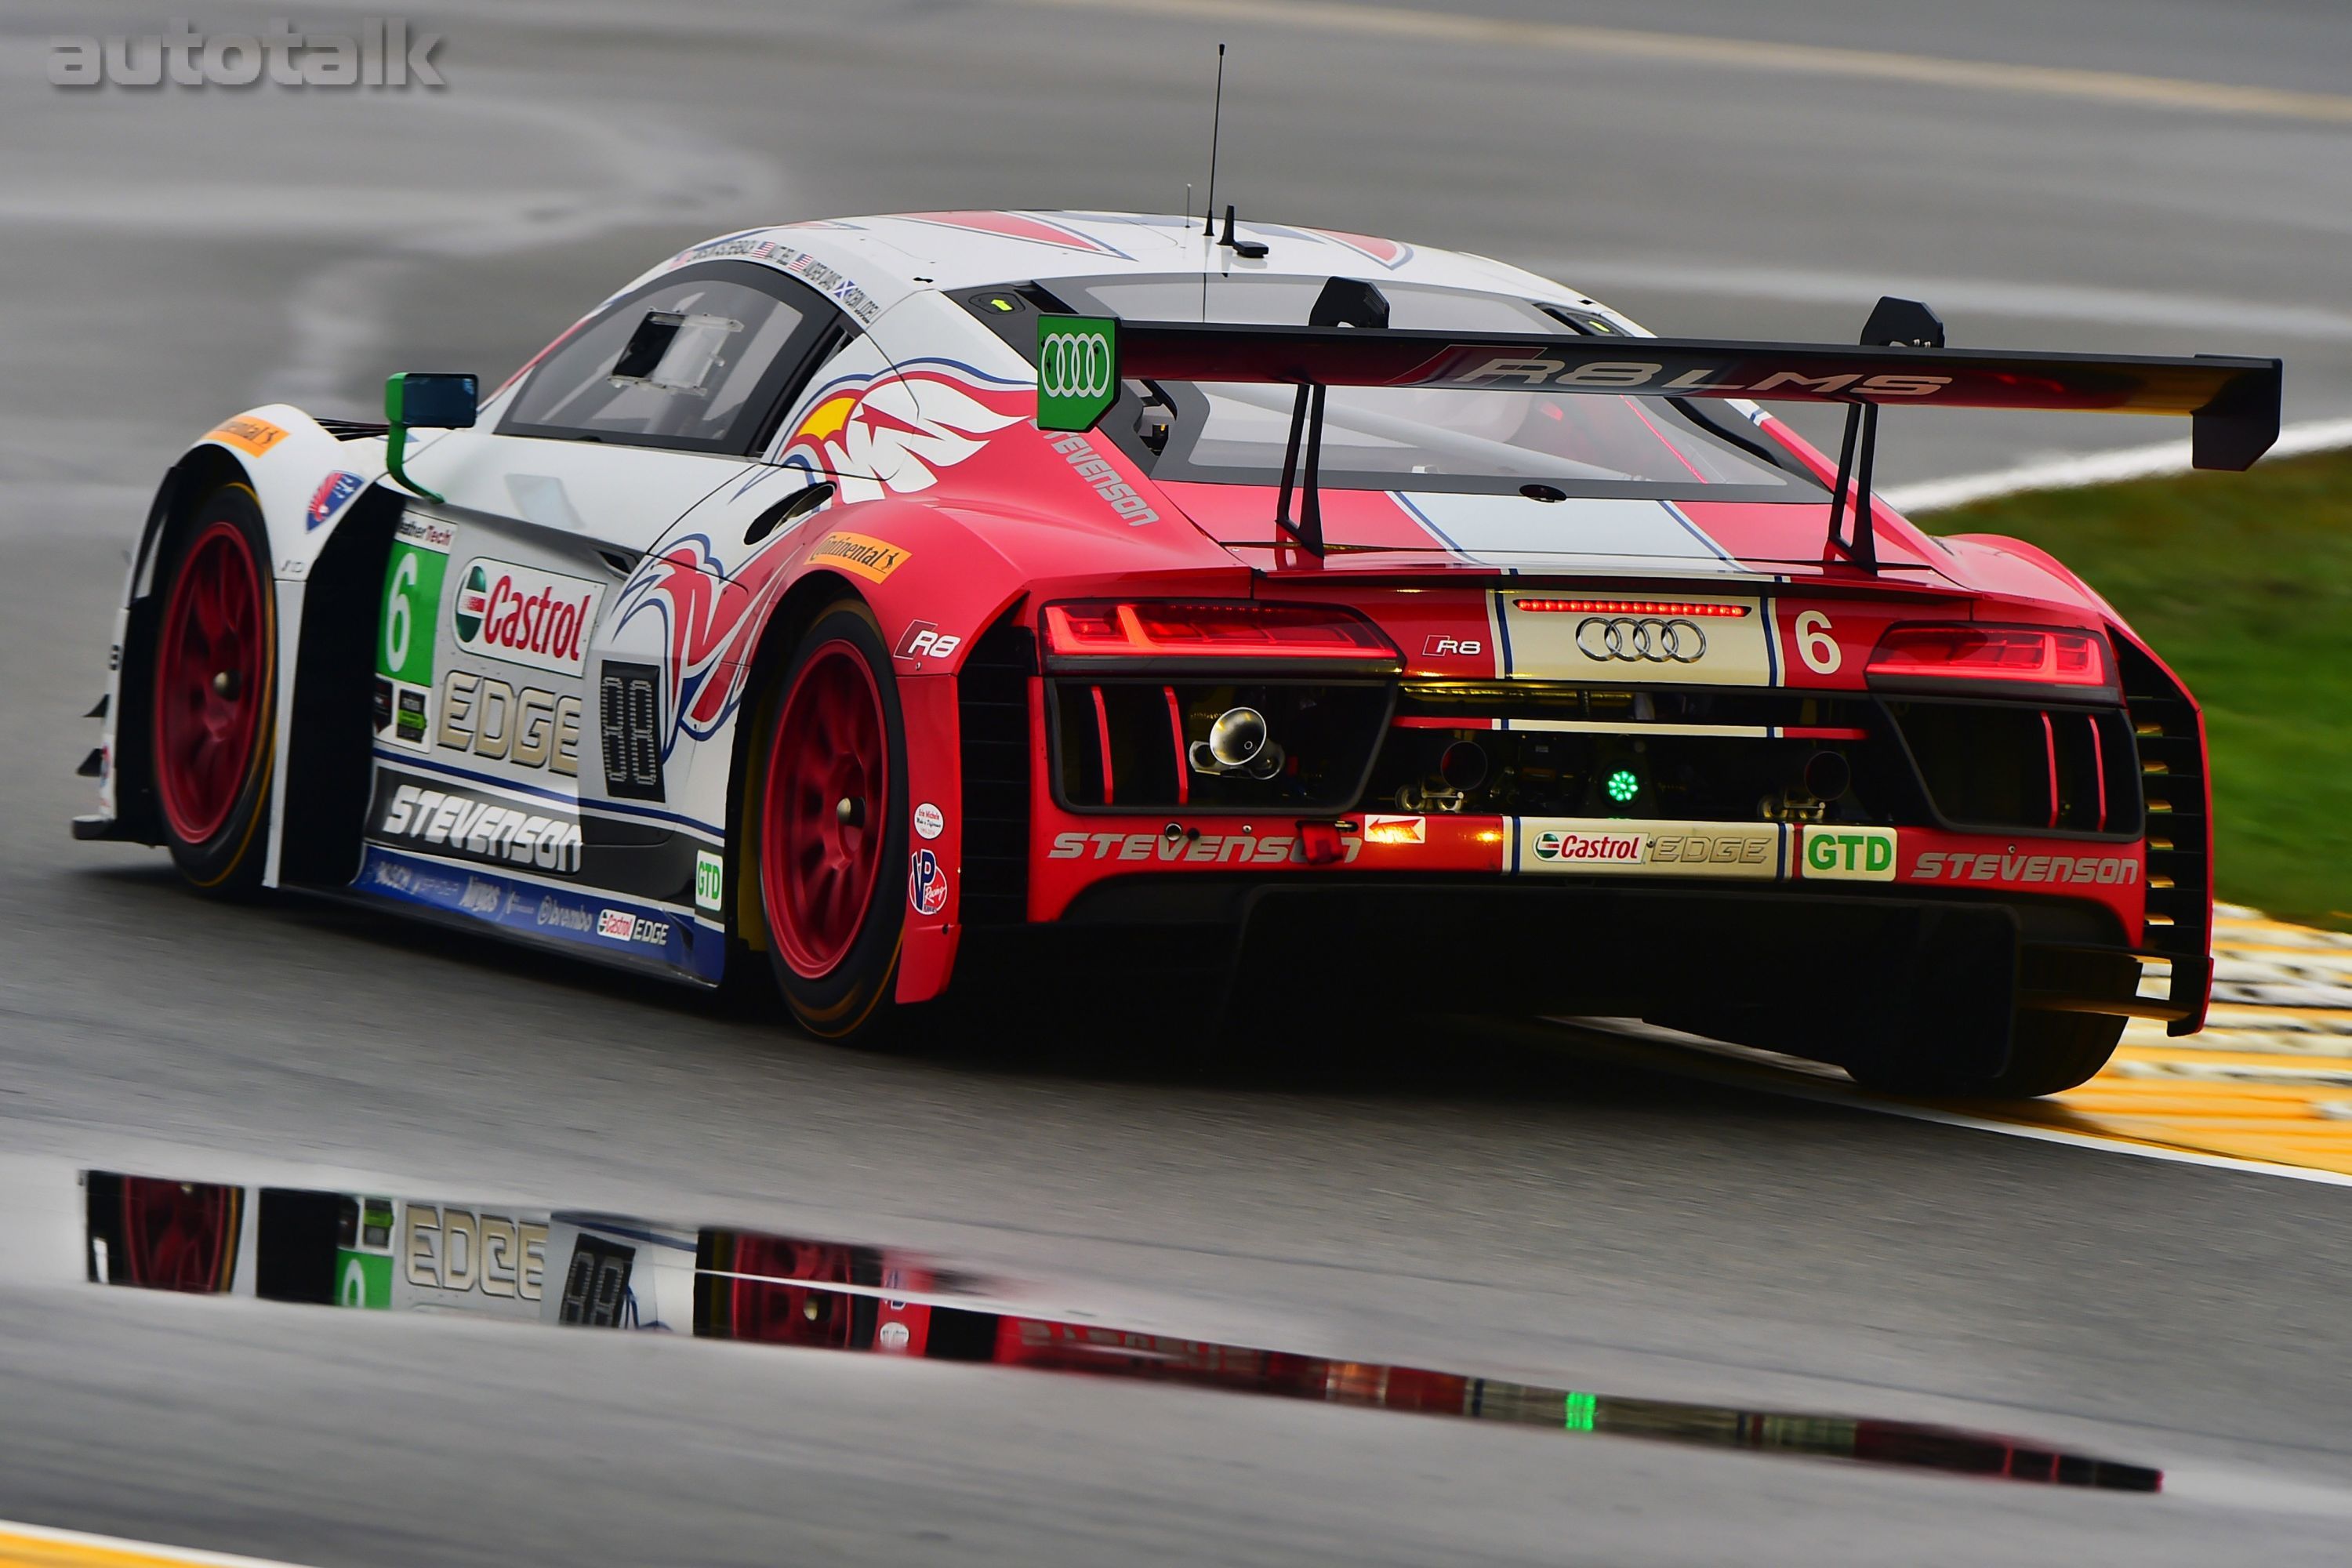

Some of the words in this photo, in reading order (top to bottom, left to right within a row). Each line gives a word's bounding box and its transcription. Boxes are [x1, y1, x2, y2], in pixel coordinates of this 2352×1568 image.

[1454, 358, 1663, 387] R8
[1661, 369, 1953, 396] LMS
[400, 518, 452, 546] eatherTech
[810, 535, 889, 569] Continental
[385, 552, 418, 673] 6
[484, 575, 591, 662] Castrol
[908, 630, 962, 659] R8
[1436, 639, 1480, 655] R8
[1795, 610, 1842, 675] 6
[436, 670, 583, 778] EDGE
[383, 784, 583, 873] STEVENSON
[1560, 833, 1640, 860] Castrol
[1650, 835, 1772, 865] EDGE
[1807, 833, 1893, 872] GTD
[1911, 851, 2139, 885] STEVENSON
[698, 860, 720, 900] GTD
[912, 848, 936, 912] VP
[548, 898, 593, 932] brembo
[605, 913, 633, 937] Castrol
[633, 919, 670, 946] EDGE
